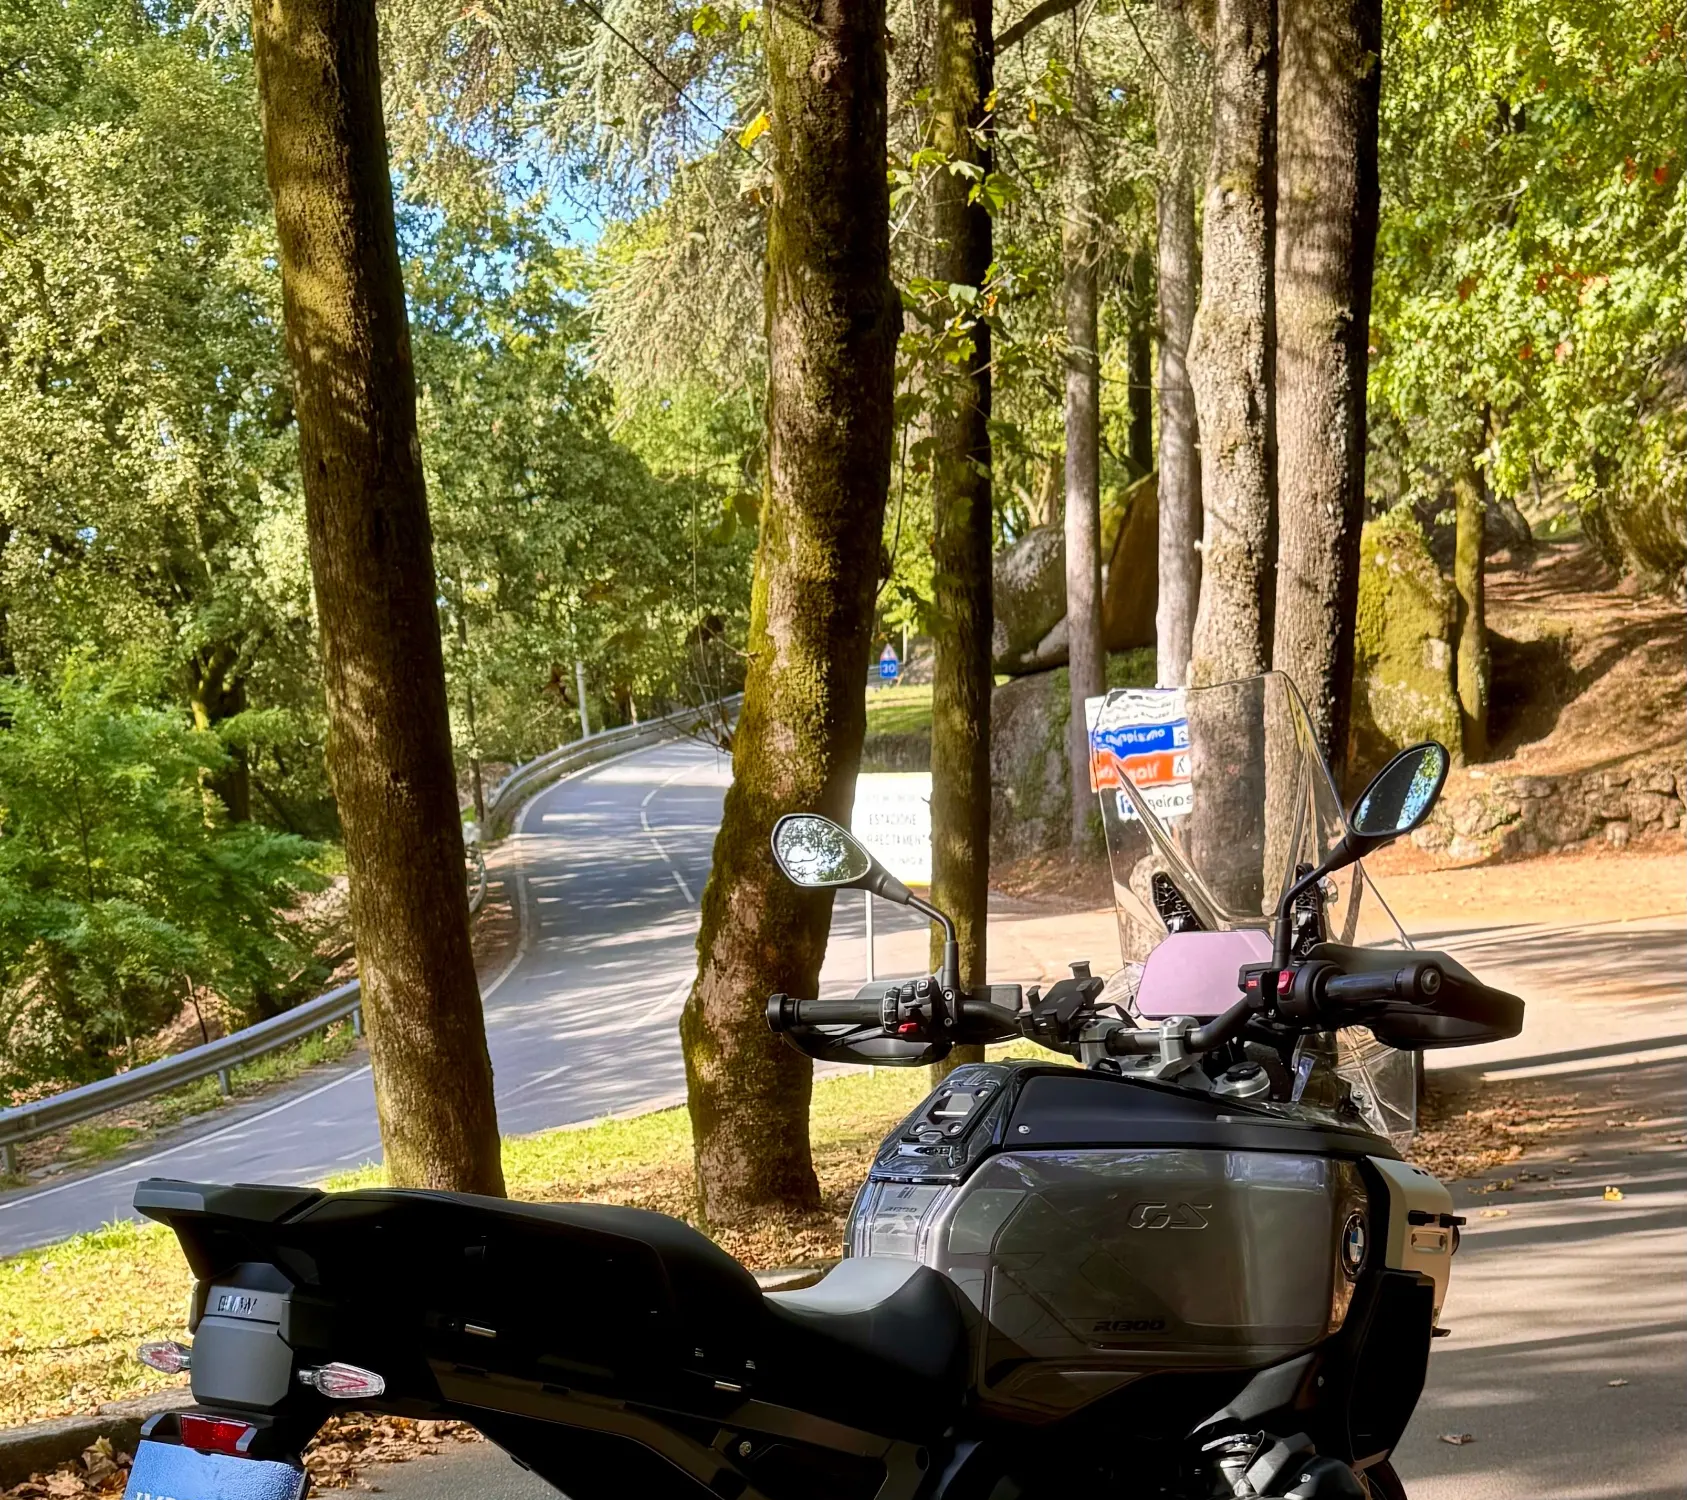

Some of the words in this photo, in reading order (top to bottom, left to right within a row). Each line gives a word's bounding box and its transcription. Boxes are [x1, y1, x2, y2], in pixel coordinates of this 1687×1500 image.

[882, 663, 896, 674] 30
[1128, 1202, 1213, 1230] GS
[218, 1295, 258, 1315] BMW
